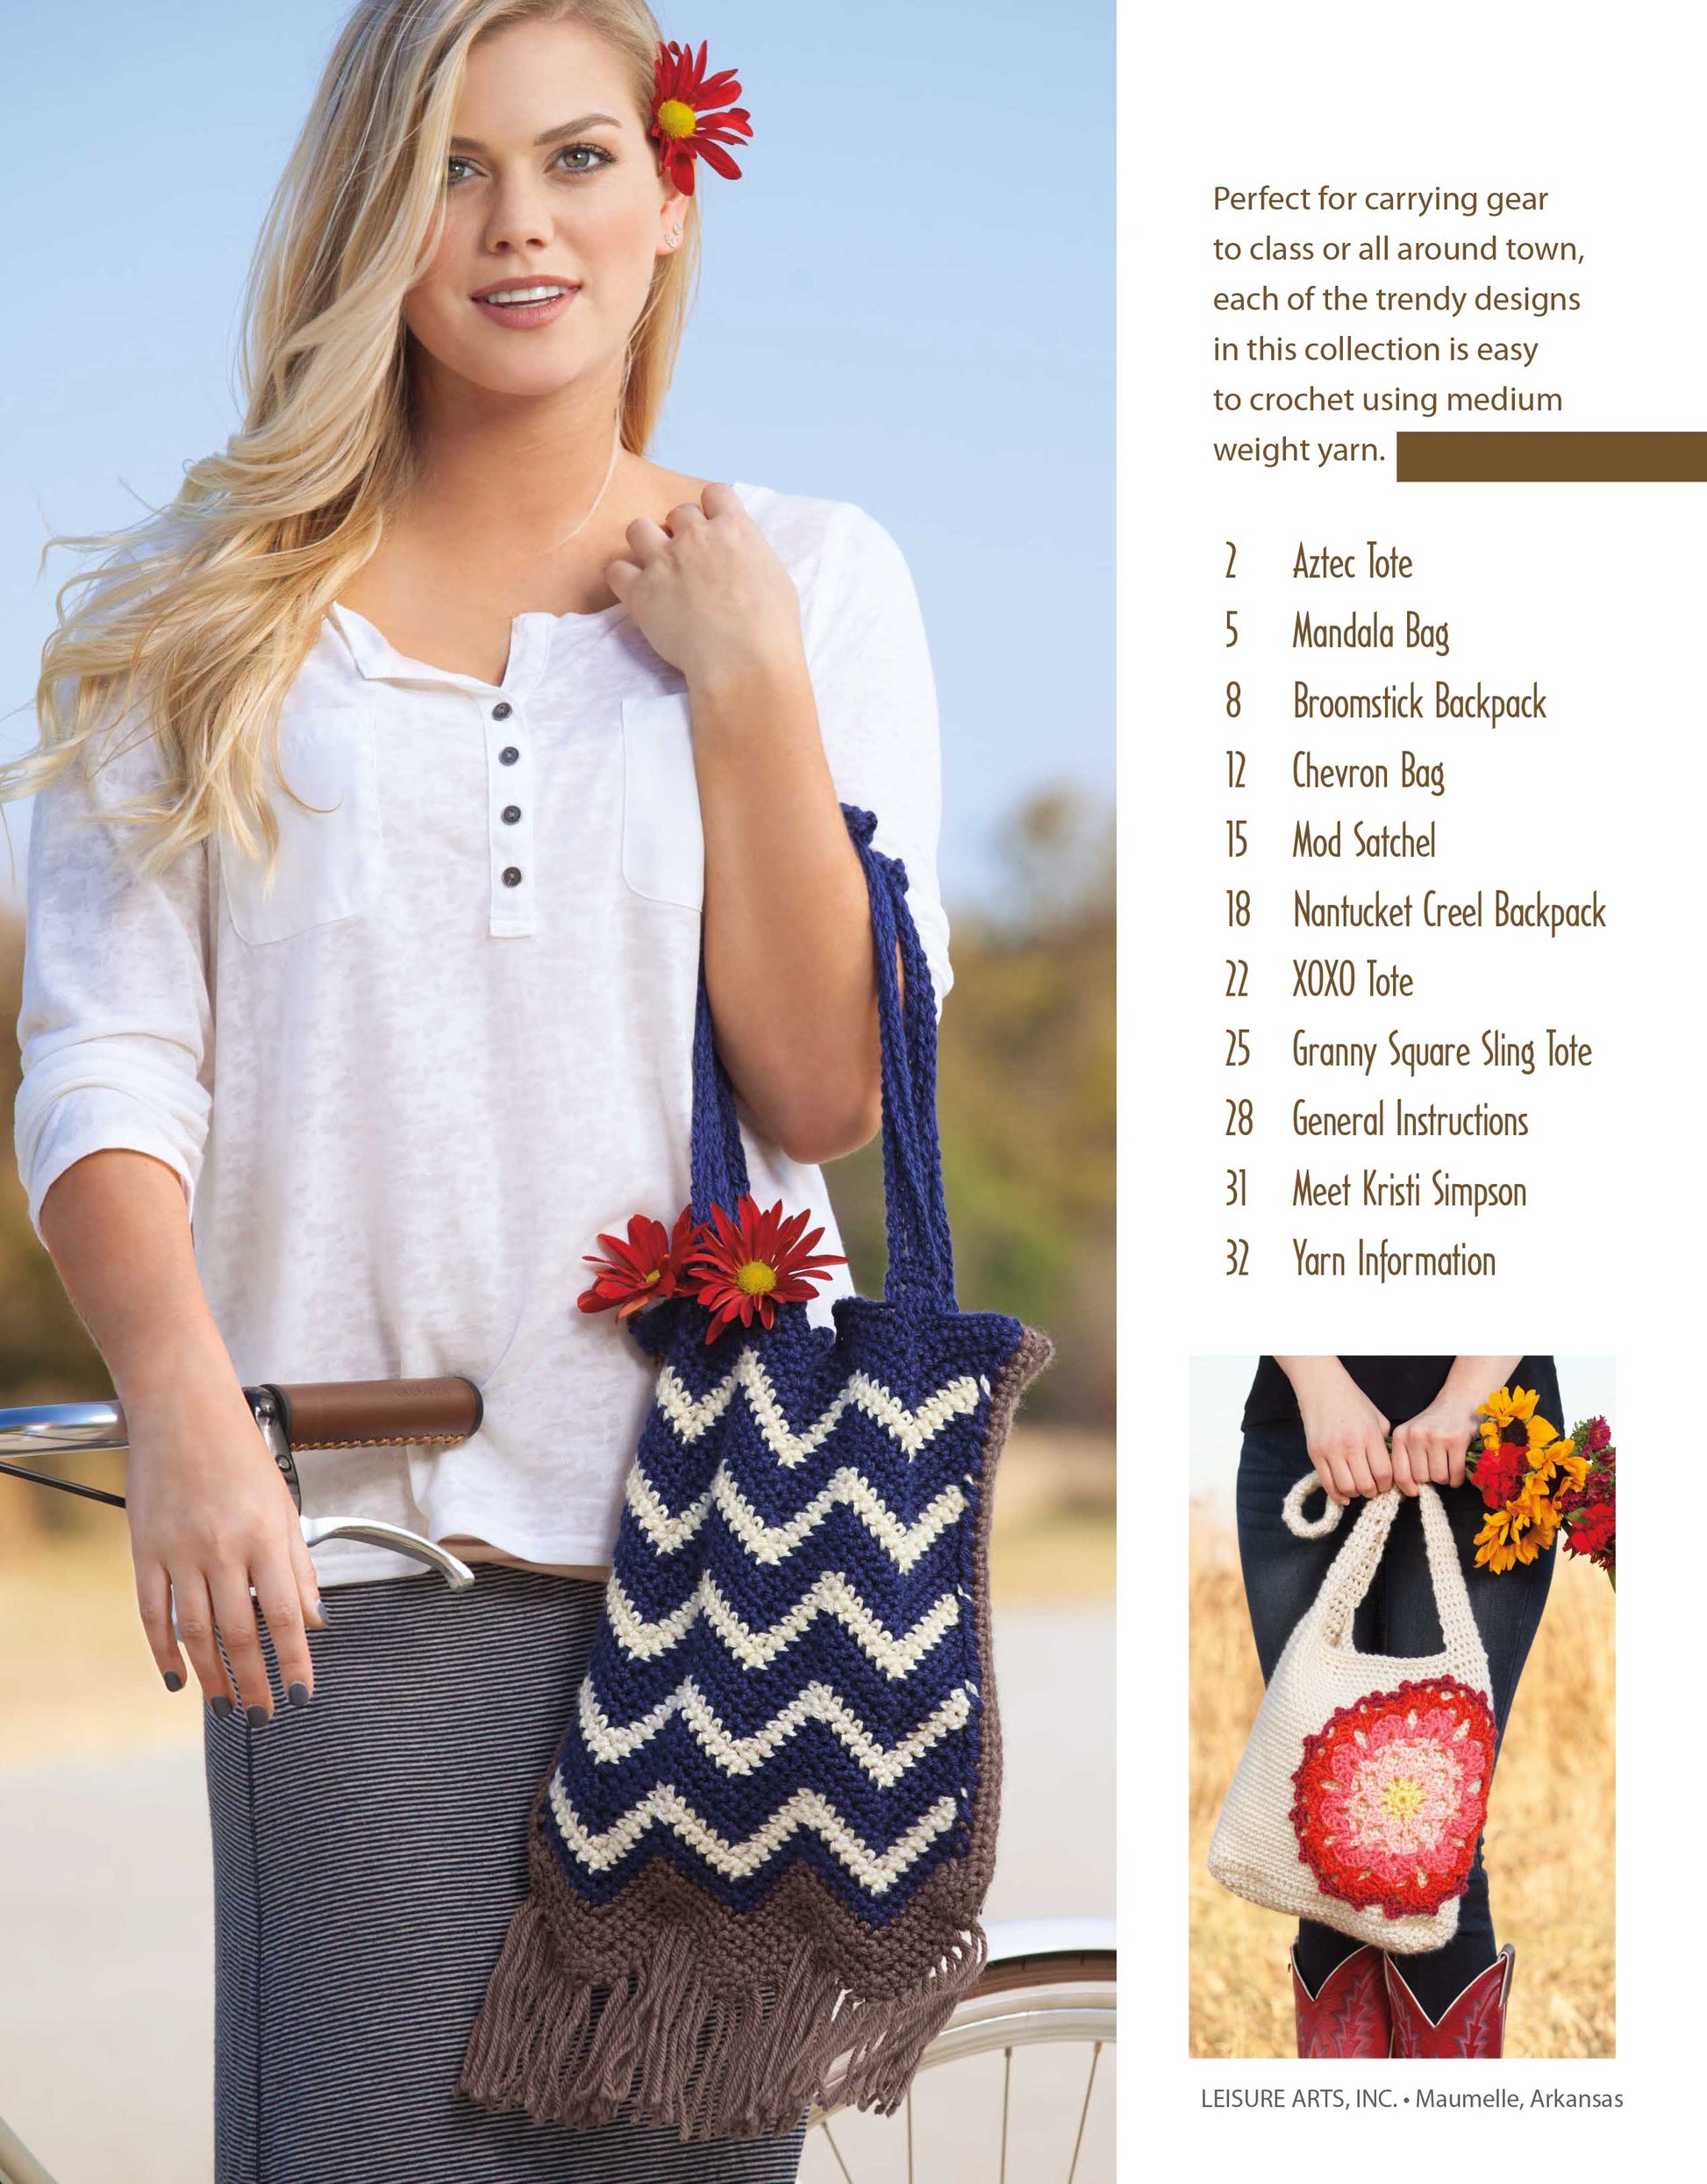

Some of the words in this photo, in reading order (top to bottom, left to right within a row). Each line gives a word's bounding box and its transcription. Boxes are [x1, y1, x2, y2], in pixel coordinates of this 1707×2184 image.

[1214, 184, 1311, 211] Perfect
[1318, 184, 1358, 211] for
[1365, 186, 1477, 218] carrying
[1487, 192, 1549, 218] gear
[1213, 239, 1242, 261] to
[1249, 234, 1314, 261] class
[1323, 242, 1352, 261] or
[1359, 234, 1389, 261] all
[1397, 234, 1496, 261] around
[1505, 239, 1584, 265] town,
[1213, 285, 1279, 311] each
[1287, 285, 1317, 310] of
[1322, 285, 1368, 310] the
[1375, 285, 1468, 318] trendy
[1475, 285, 1581, 318] designs
[1214, 337, 1239, 361] in
[1246, 335, 1296, 361] this
[1304, 335, 1439, 361] collection
[1450, 337, 1469, 361] is
[1477, 342, 1539, 368] easy
[1212, 389, 1242, 411] to
[1249, 385, 1354, 411] crochet
[1363, 387, 1438, 418] using
[1447, 385, 1562, 411] medium
[1213, 435, 1311, 468] weight
[1317, 443, 1385, 468] yarn.
[1225, 540, 1237, 579] 2
[1292, 540, 1356, 579] Aztec
[1366, 540, 1413, 579] Tote
[1225, 610, 1239, 648] 5
[1292, 610, 1394, 648] Mandala
[1406, 610, 1450, 657] Bag
[1225, 681, 1241, 718] 8
[1295, 681, 1424, 718] Broomstick
[1436, 681, 1547, 730] Backpack
[1225, 750, 1246, 789] 12
[1293, 750, 1388, 789] Chevron
[1402, 750, 1446, 797] Bag
[1225, 819, 1247, 858] 15
[1292, 820, 1341, 858] Mod
[1353, 820, 1435, 858] Satchel
[1225, 889, 1251, 927] 18
[1295, 889, 1413, 927] Nantucket
[1423, 889, 1482, 927] Creel
[1495, 889, 1607, 939] Backpack
[1225, 959, 1249, 997] 22
[1292, 959, 1355, 997] XOXO
[1366, 959, 1414, 997] Tote
[1225, 1029, 1250, 1067] 25
[1293, 1029, 1378, 1077] Granny
[1388, 1029, 1471, 1078] Square
[1482, 1029, 1536, 1075] Sling
[1546, 1029, 1592, 1067] Tote
[1225, 1098, 1253, 1136] 28
[1293, 1098, 1384, 1136] General
[1396, 1098, 1529, 1136] Instructions
[1225, 1168, 1246, 1207] 31
[1292, 1168, 1352, 1206] Meet
[1363, 1168, 1420, 1207] Kristi
[1432, 1168, 1526, 1217] Simpson
[1225, 1238, 1249, 1276] 32
[1292, 1238, 1346, 1276] Yarn
[1359, 1238, 1496, 1284] Information
[1202, 2088, 1285, 2108] LEISURE
[1291, 2088, 1350, 2110] ARTS,
[1356, 2088, 1397, 2108] INC.
[1416, 2088, 1525, 2110] Maumelle,
[1530, 2088, 1624, 2108] Arkansas
